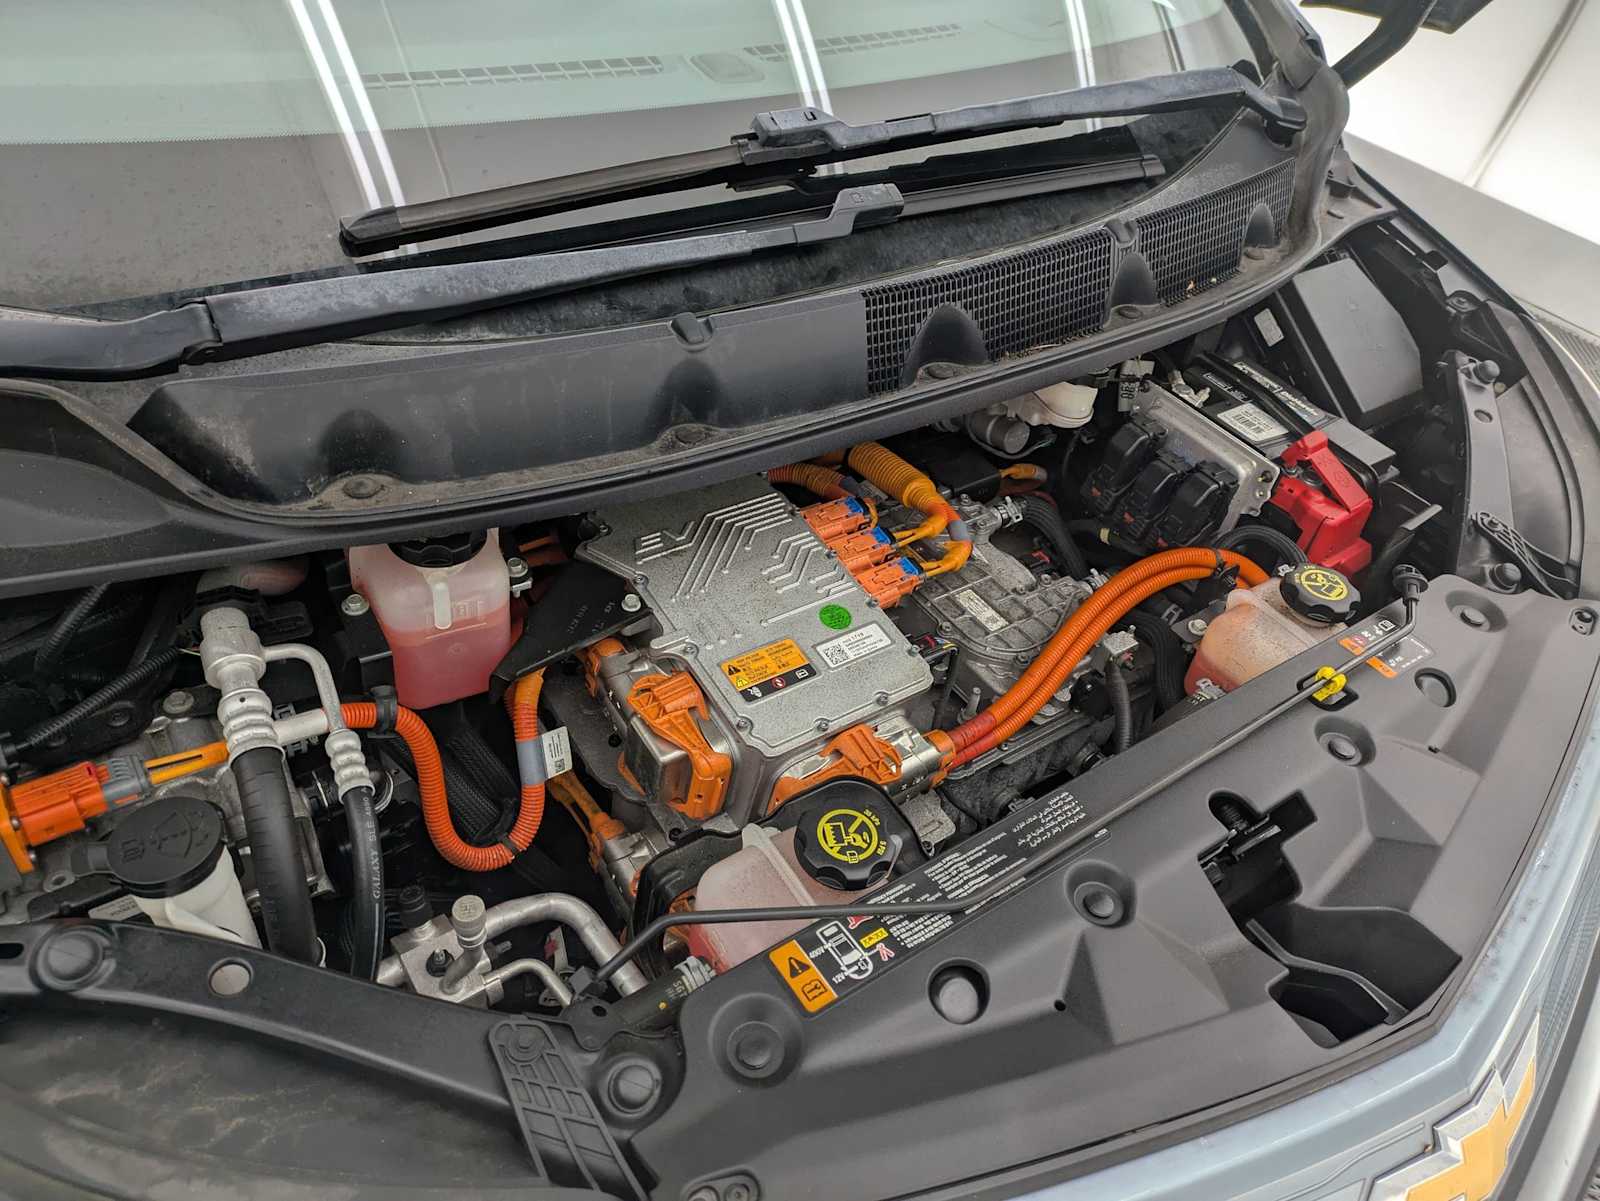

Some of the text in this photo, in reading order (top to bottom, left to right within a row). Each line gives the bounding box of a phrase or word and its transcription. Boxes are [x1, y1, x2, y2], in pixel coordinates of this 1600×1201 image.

[634, 521, 696, 555] EV
[368, 820, 377, 841] SLE
[371, 848, 381, 899] GALAXY
[832, 971, 846, 985] 12V
